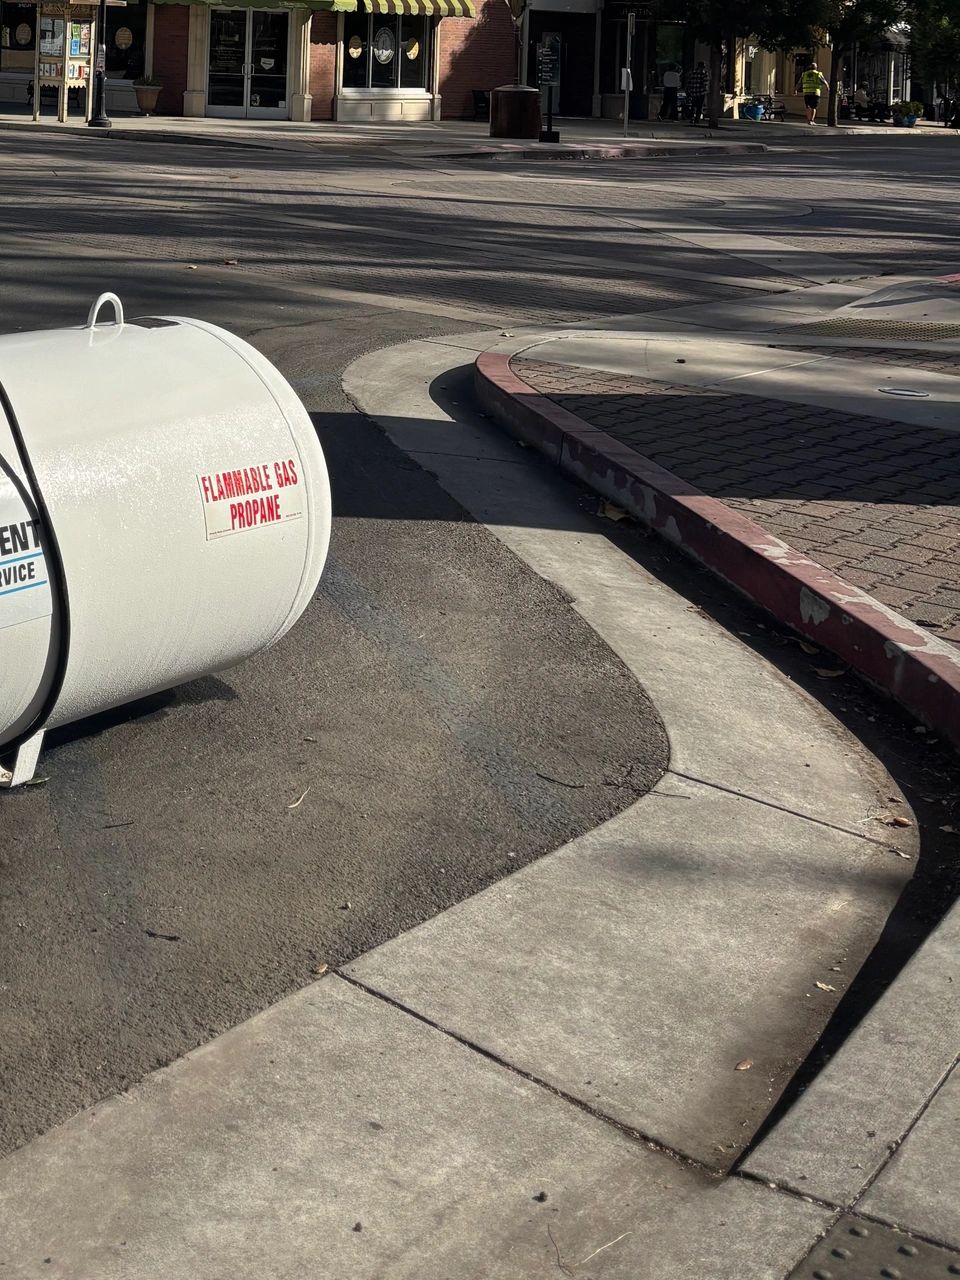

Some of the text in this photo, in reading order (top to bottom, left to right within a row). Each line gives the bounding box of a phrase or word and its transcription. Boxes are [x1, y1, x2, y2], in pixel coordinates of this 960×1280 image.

[201, 459, 298, 503] FLAMMABLE GAS
[230, 494, 281, 530] PROPANE
